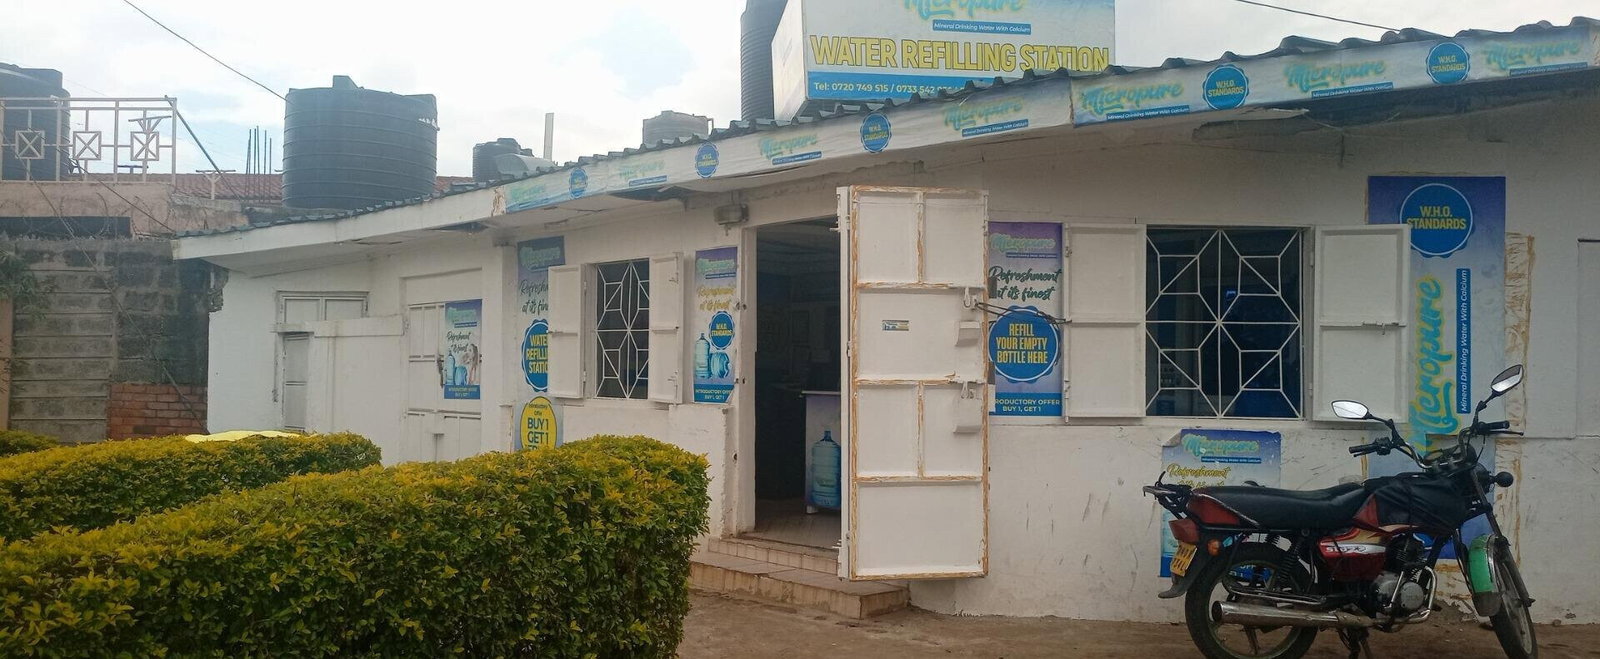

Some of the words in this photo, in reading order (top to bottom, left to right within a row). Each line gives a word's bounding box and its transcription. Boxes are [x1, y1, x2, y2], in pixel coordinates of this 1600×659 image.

[809, 35, 898, 68] WATER
[901, 39, 1016, 72] REFILLING
[1019, 44, 1109, 72] STATION
[814, 82, 829, 91] Tel:
[832, 82, 853, 91] 0720
[856, 83, 872, 92] 749
[875, 84, 888, 93] 515
[896, 84, 917, 94] 0733
[919, 85, 934, 94] 542
[1208, 86, 1244, 97] STANDARDS
[1081, 83, 1183, 115] Micropure
[1420, 206, 1452, 217] W.H.O.
[1407, 217, 1466, 230] STANDARDS
[988, 266, 1062, 284] Refreshment
[1008, 285, 1020, 300] its
[1022, 286, 1055, 302] finest
[1009, 323, 1034, 336] REFILL
[530, 334, 548, 346] WATE
[996, 337, 1019, 350] YOUR
[1020, 337, 1048, 350] EMPTY
[997, 350, 1025, 363] BOTTLE
[1027, 351, 1048, 363] HERE
[1460, 348, 1469, 381] Drinking
[528, 417, 544, 430] BUY
[527, 431, 544, 444] GET
